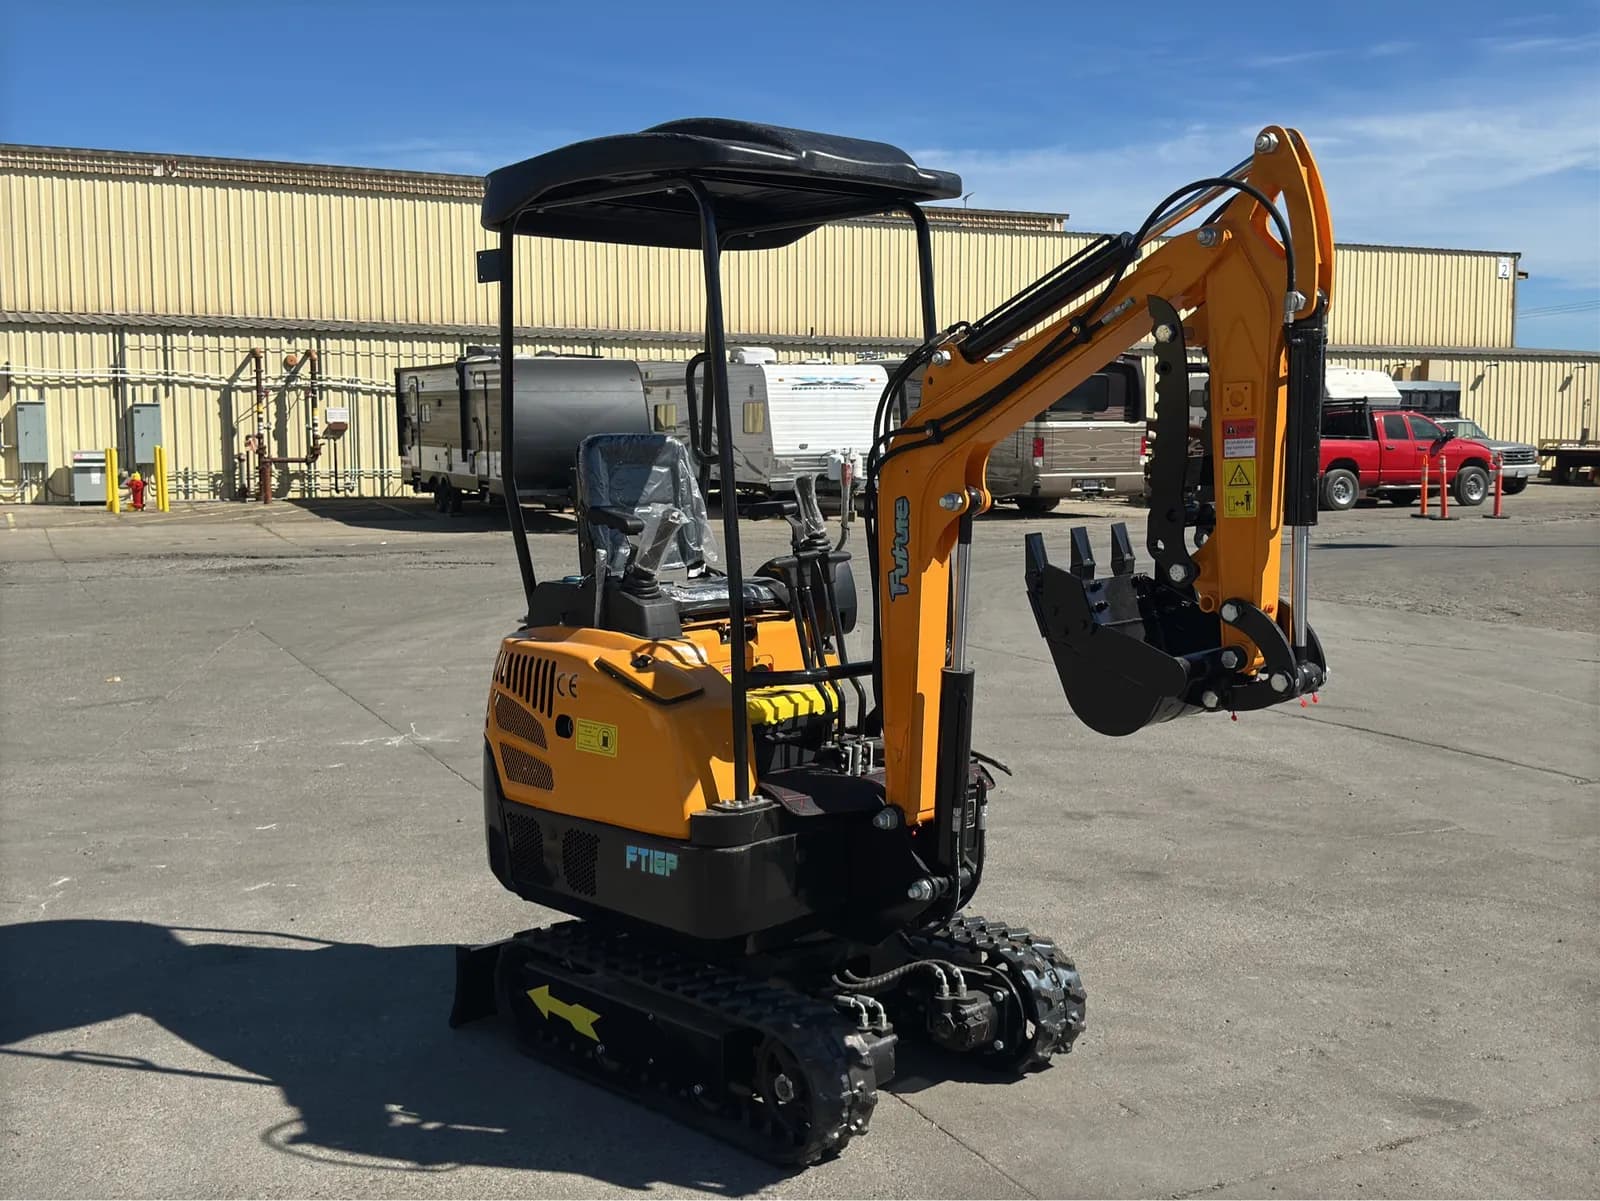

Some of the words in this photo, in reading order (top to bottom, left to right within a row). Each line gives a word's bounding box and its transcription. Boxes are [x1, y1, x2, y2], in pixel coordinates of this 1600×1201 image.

[1501, 264, 1508, 277] 2
[888, 496, 910, 602] Future
[557, 673, 578, 698] CE
